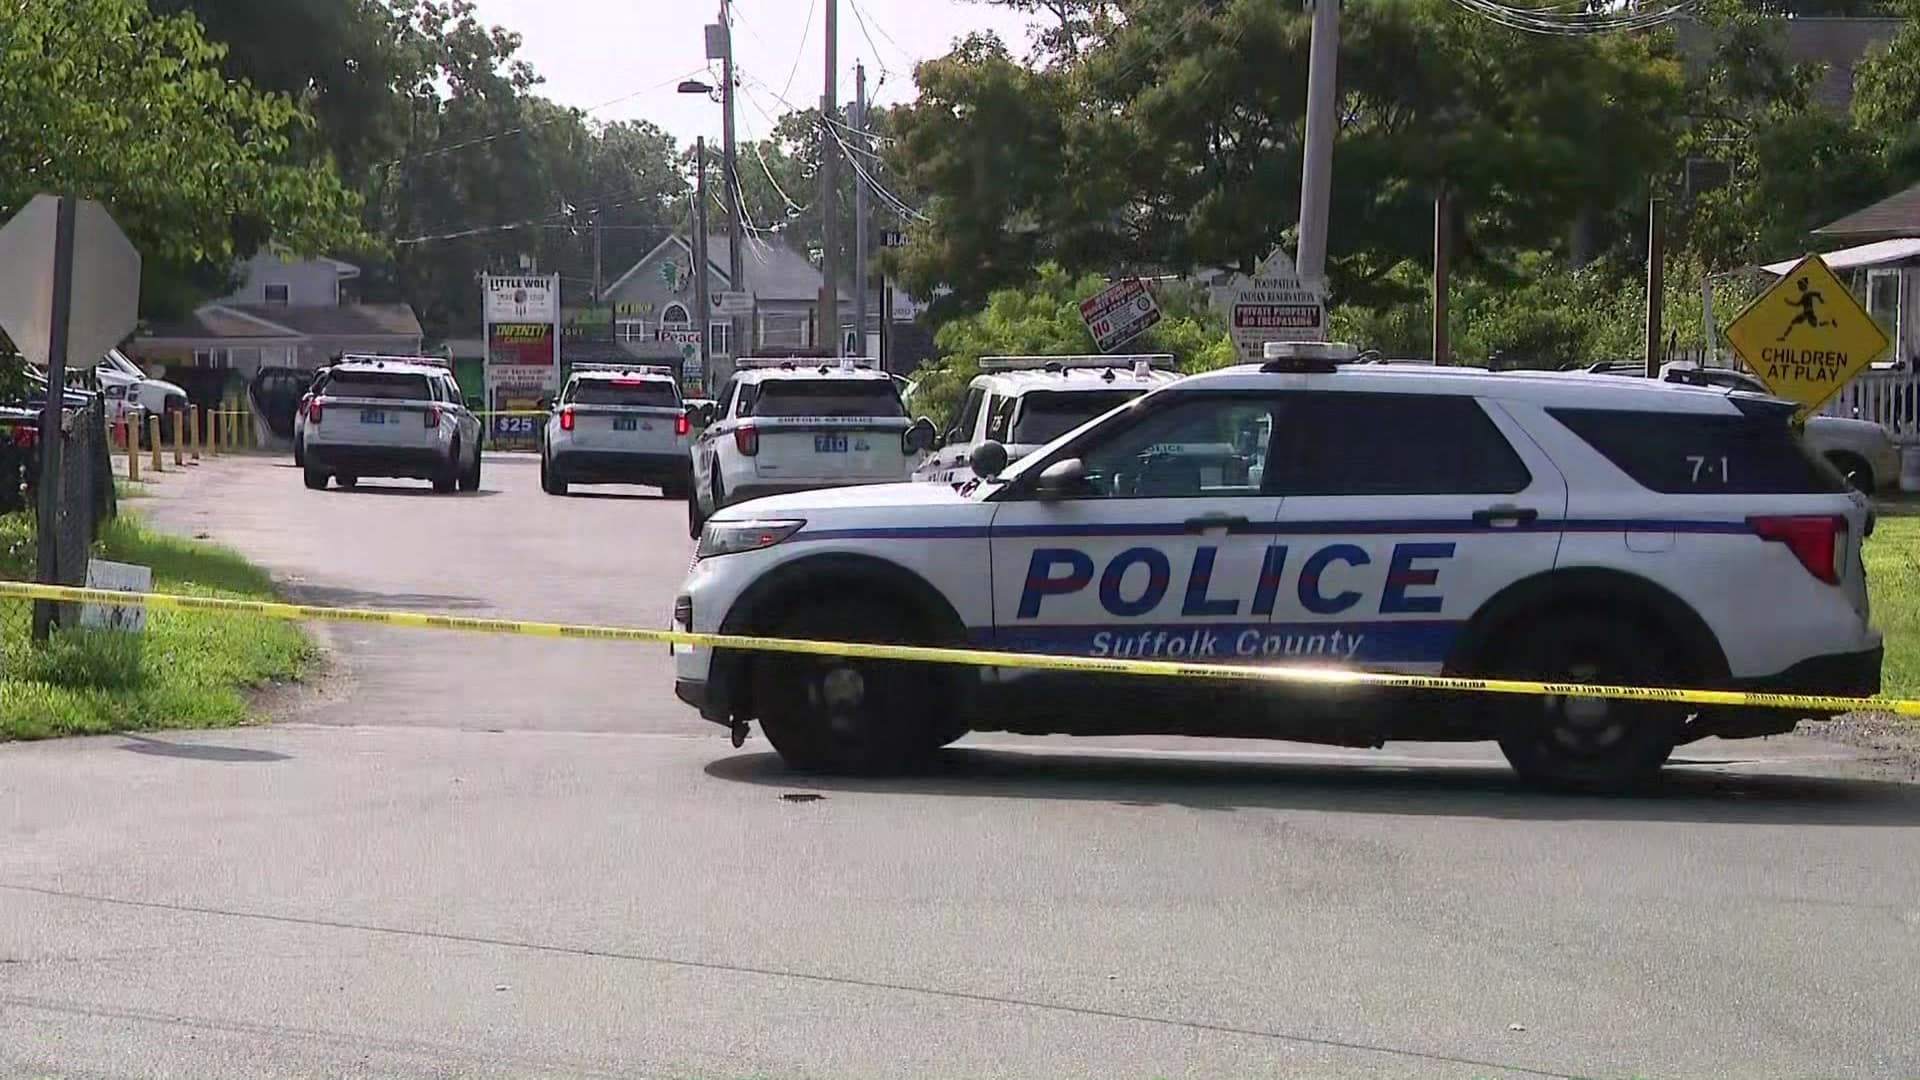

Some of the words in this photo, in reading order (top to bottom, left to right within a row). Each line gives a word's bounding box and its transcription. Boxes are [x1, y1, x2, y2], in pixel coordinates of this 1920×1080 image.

[496, 323, 548, 336] INFINITY
[1092, 320, 1110, 339] NO
[1761, 347, 1848, 368] CHILDREN
[1767, 364, 1790, 380] AT
[1795, 366, 1838, 383] PLAY
[500, 417, 532, 431] $25
[1017, 541, 1457, 619] POLICE
[1089, 629, 1217, 658] Suffolk
[1236, 629, 1365, 659] County
